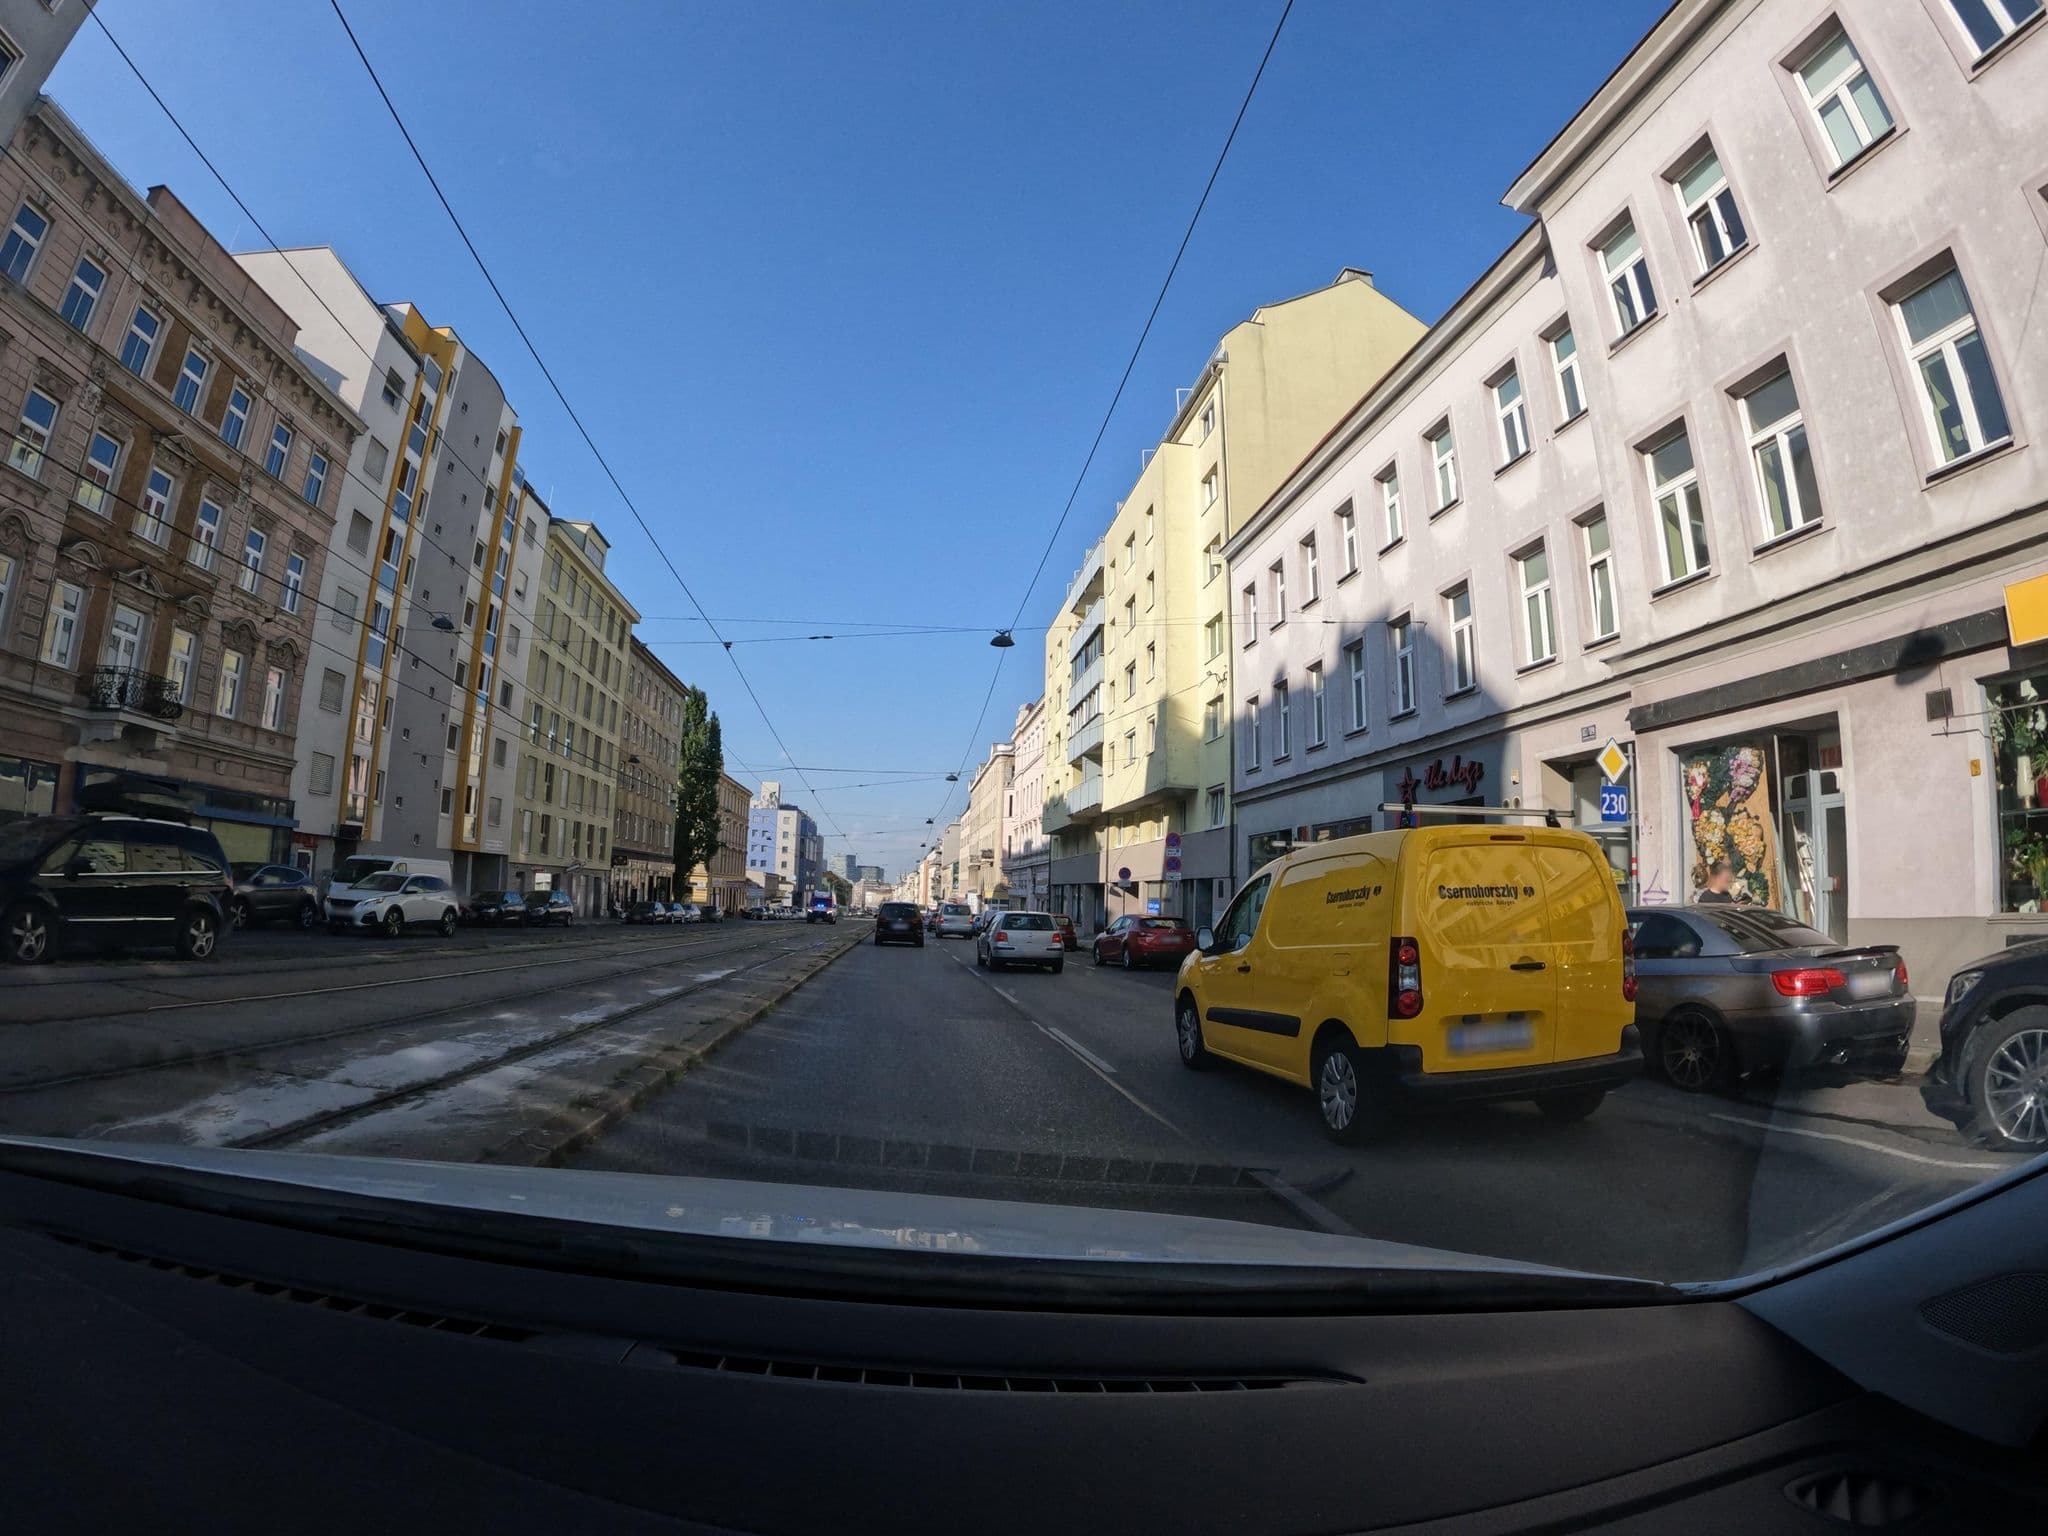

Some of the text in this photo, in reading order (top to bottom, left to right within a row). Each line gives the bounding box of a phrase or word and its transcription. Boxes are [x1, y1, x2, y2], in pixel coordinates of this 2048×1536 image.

[1602, 793, 1626, 815] 230
[1326, 886, 1371, 905] Csernohorszky
[1438, 884, 1518, 900] Csernohorszky
